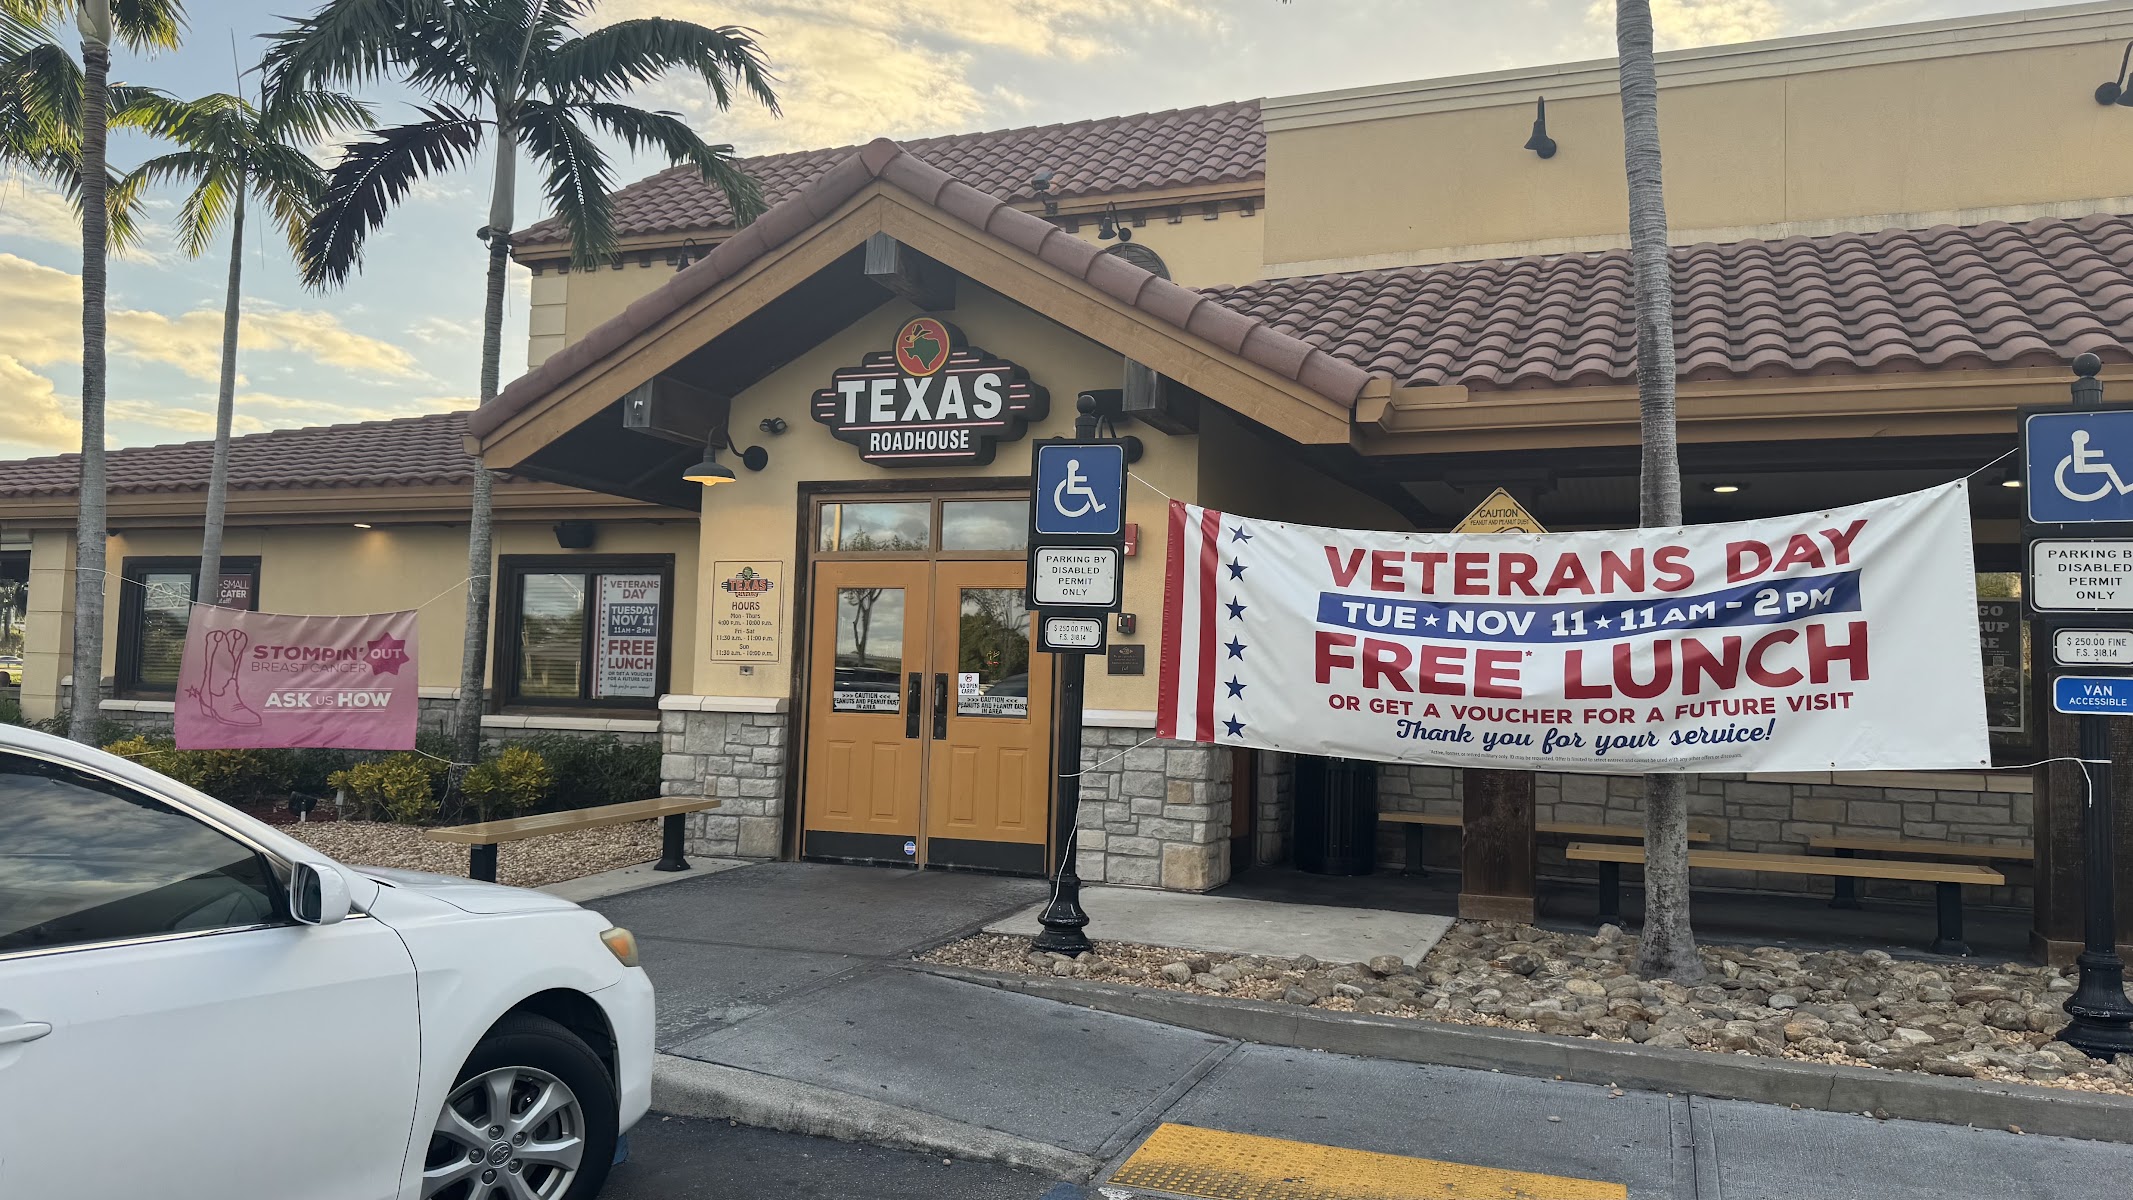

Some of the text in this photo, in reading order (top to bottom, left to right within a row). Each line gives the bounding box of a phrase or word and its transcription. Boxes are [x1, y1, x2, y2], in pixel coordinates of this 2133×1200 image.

[837, 373, 1002, 423] TEXAS
[870, 430, 969, 451] ROADHOUSE
[1480, 509, 1518, 518] CAUTION
[1324, 520, 1868, 596] VETERANS DAY
[2048, 550, 2133, 558] PARKING B
[2058, 563, 2132, 572] DISABLED
[730, 580, 766, 590] TEXAS
[2069, 577, 2122, 586] PERMIT
[221, 590, 247, 598] CATER
[623, 589, 647, 599] DAY
[2076, 591, 2115, 599] ONLY
[612, 606, 655, 614] TUESDAY
[732, 602, 760, 610] HOURS
[612, 615, 654, 626] NOV 11
[1342, 602, 1417, 630] TUE
[1447, 610, 1536, 636] NOV
[1551, 610, 1588, 636] 11
[2066, 637, 2127, 646] $ 250.00 FINE
[253, 645, 401, 661] STOMPIN' OUT
[2093, 649, 2117, 657] 318.14
[608, 658, 653, 670] LUNCH
[1564, 621, 1870, 699] LUNCH
[251, 662, 366, 673] BREAST CANCER
[2084, 685, 2112, 696] VAN
[264, 692, 392, 707] ASK US HOW
[2069, 697, 2127, 706] ACCESSIBLE
[1328, 692, 1854, 724] OR GET A VOUCHER FOR A FUTURE VISIT
[1397, 718, 1776, 755] Thank you for your service!
